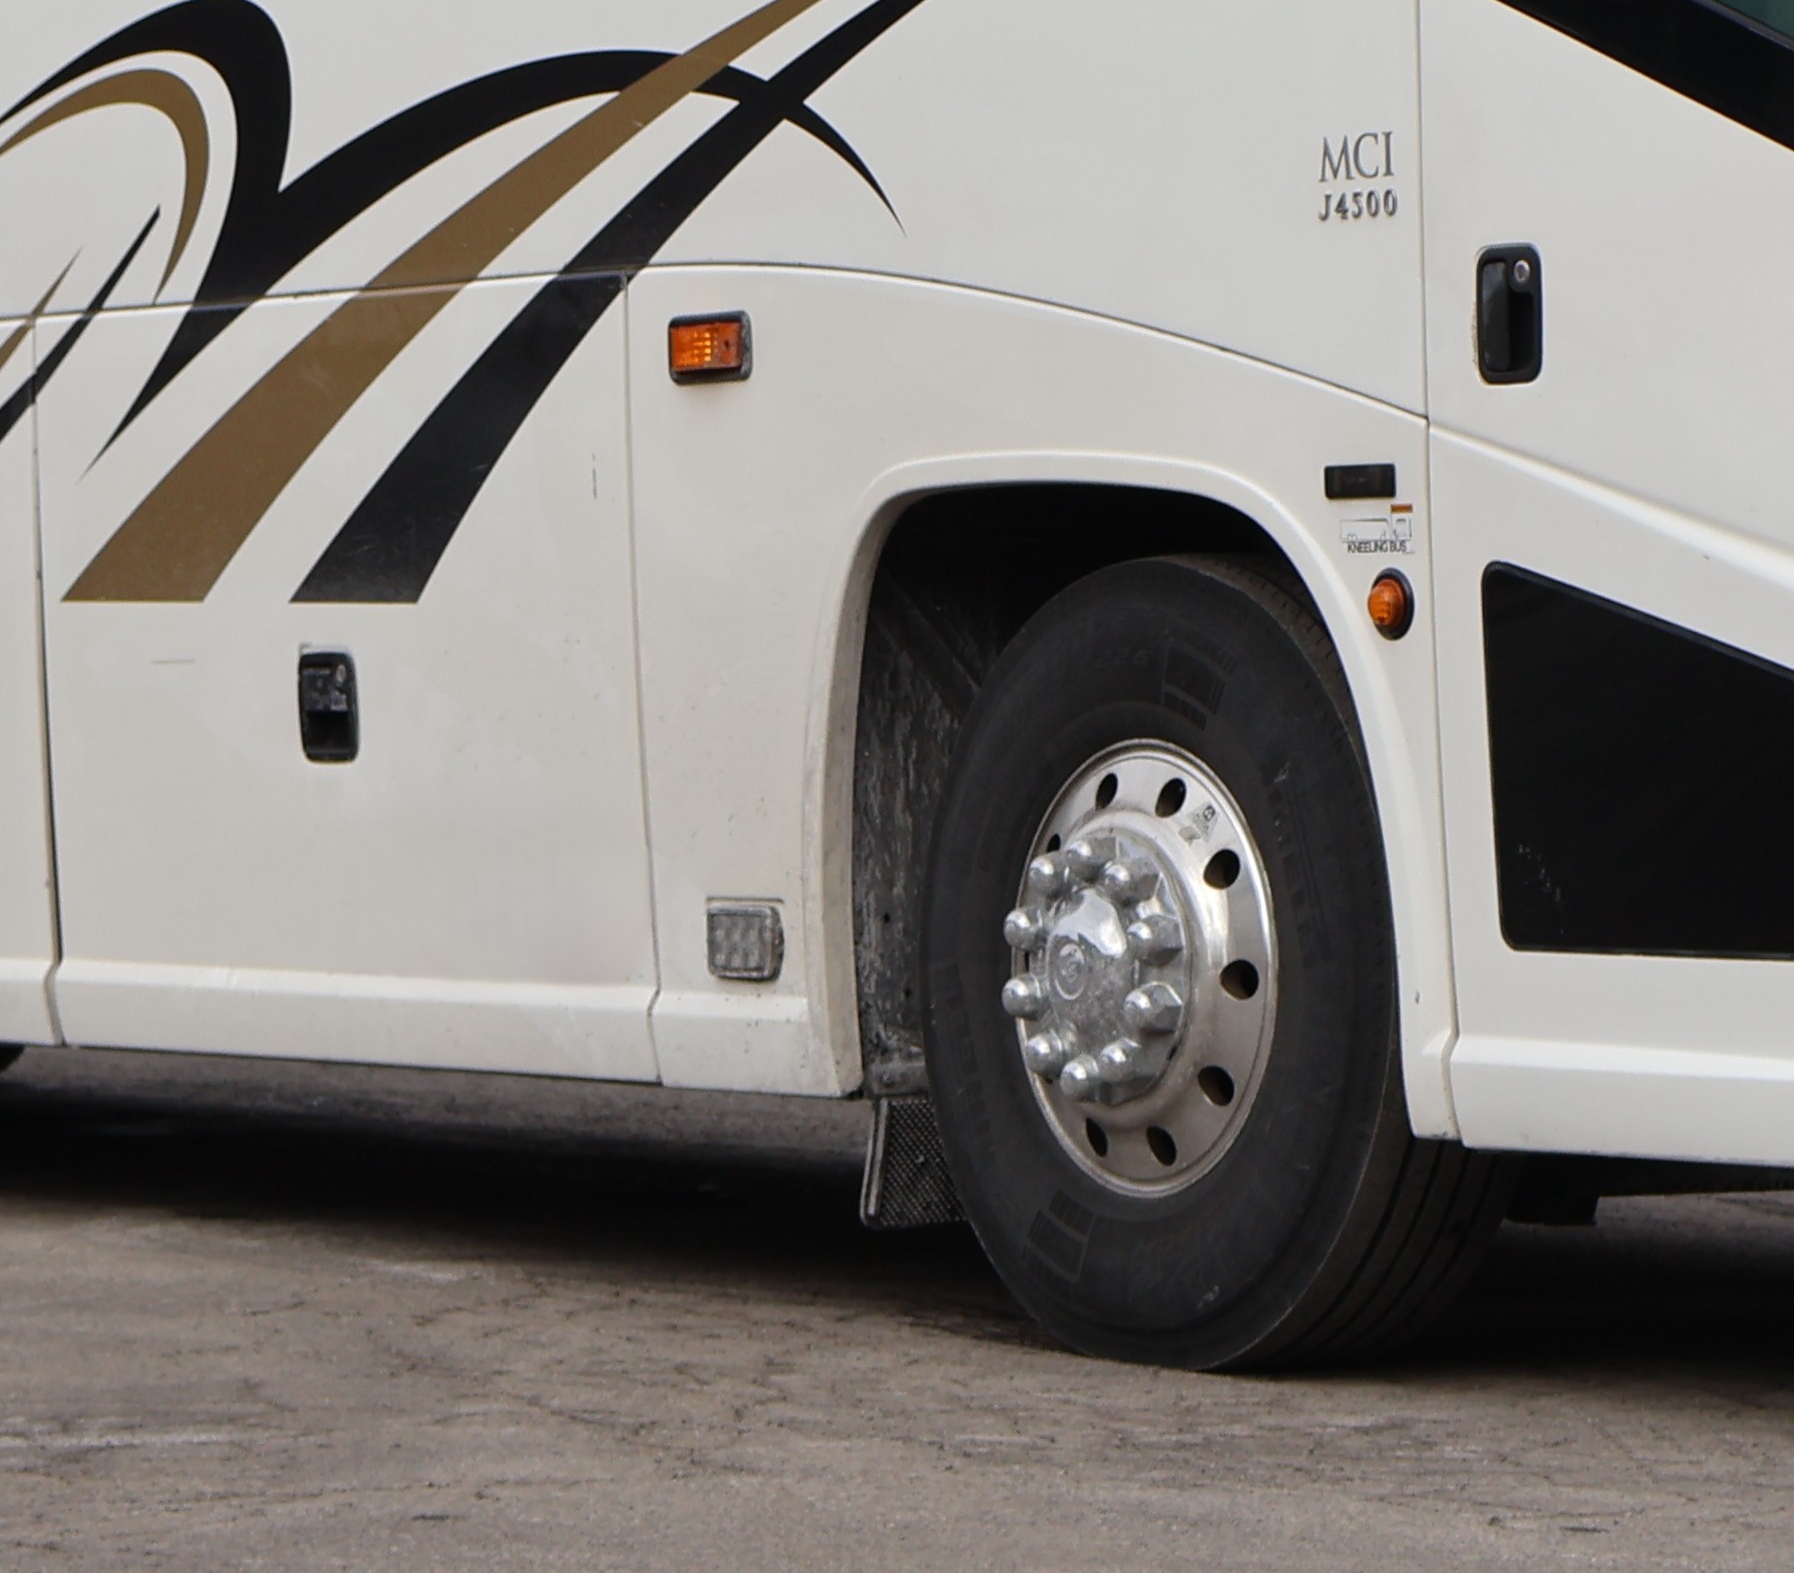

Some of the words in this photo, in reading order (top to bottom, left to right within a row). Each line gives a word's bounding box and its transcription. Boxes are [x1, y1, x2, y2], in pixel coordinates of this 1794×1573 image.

[1319, 131, 1395, 183] MCI
[1318, 188, 1398, 222] J4500
[1347, 539, 1389, 554] KNEELING
[1389, 539, 1407, 553] BUS
